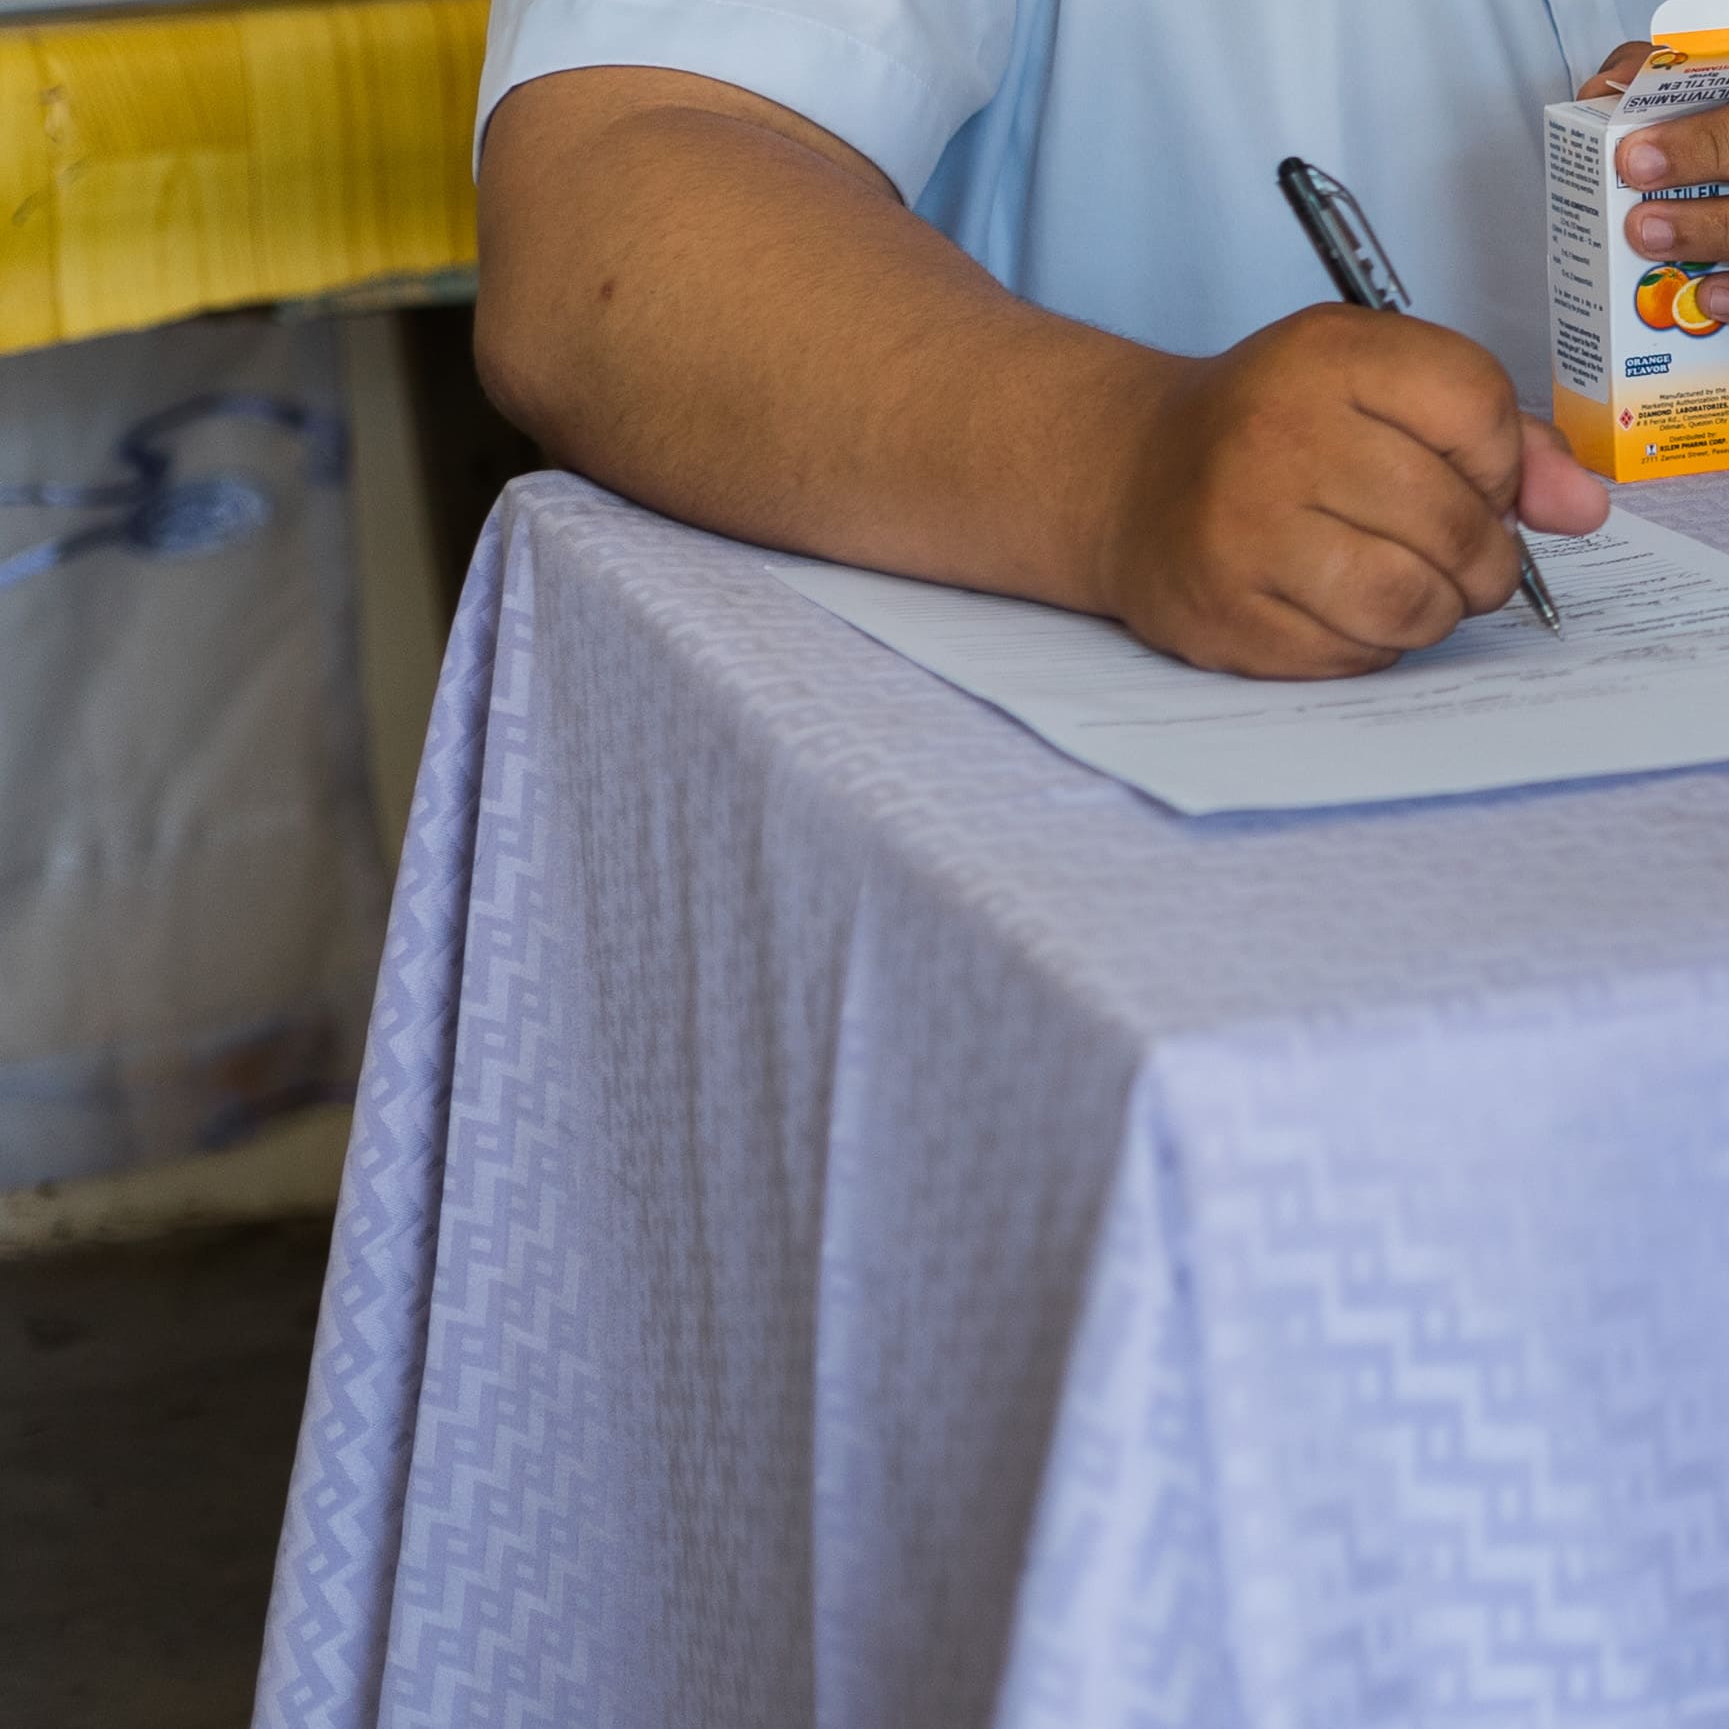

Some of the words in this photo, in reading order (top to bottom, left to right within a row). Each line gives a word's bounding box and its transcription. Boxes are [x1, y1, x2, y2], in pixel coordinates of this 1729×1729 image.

[1627, 355, 1670, 367] ORANGE
[1627, 365, 1668, 376] FLAVOR
[1660, 390, 1704, 399] Manufactured
[1642, 401, 1674, 409] Marketing
[1676, 396, 1719, 405] Authorization
[1638, 409, 1672, 419] DIAMOND
[1676, 402, 1728, 414] LABORATORIES,
[1689, 420, 1713, 428] Quezon
[1669, 433, 1705, 443] Distributed
[1681, 441, 1708, 449] PHARMA
